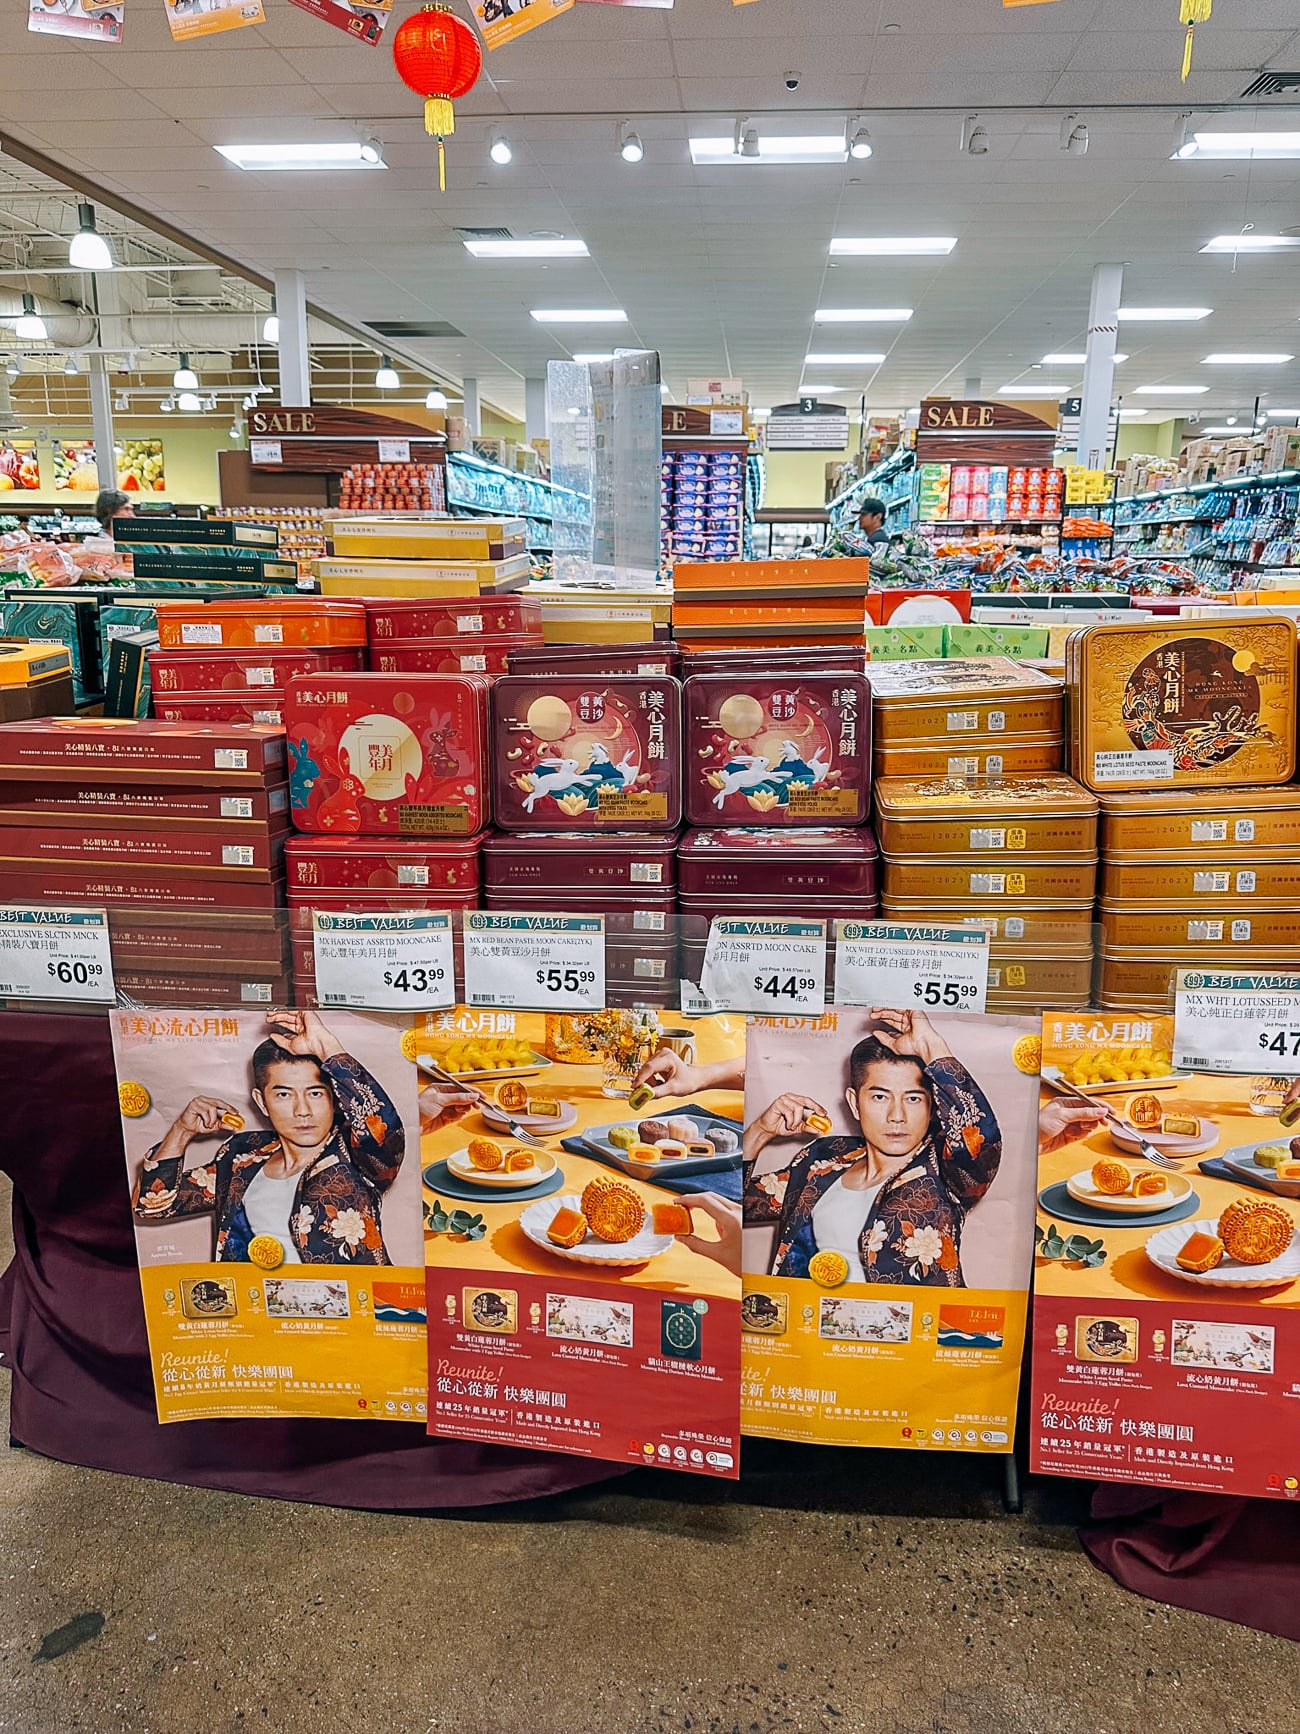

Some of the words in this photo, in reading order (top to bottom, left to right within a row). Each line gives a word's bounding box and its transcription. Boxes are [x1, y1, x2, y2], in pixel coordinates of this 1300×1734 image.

[804, 400, 813, 412] 3
[1071, 400, 1080, 411] 5
[254, 412, 316, 432] SALE
[927, 406, 995, 427] SALE
[1163, 651, 1181, 714] 美心月餅
[303, 691, 348, 704] 美心月餅
[647, 691, 666, 760] 美心月餅
[838, 688, 859, 757] 美心月餅
[31, 911, 72, 925] VALUE
[336, 918, 367, 929] BEST
[371, 918, 415, 931] VALUE
[490, 917, 523, 929] BEST
[526, 917, 569, 931] VALUE
[45, 931, 71, 940] SLCTN
[73, 931, 100, 940] MNCK
[744, 923, 789, 936] VALUE
[866, 926, 900, 938] BEST
[904, 928, 951, 942] VALUE
[319, 937, 330, 945] MX
[331, 937, 365, 946] HARVEST
[366, 938, 395, 946] ASSRTD
[396, 934, 442, 945] MOONCAKE
[729, 941, 763, 951] ASSRTD
[764, 943, 791, 952] MOON
[792, 944, 818, 953] CAKE
[320, 947, 398, 959] 美心豐年美月月餅
[470, 946, 551, 957] 美心雙黃豆沙月餅
[845, 945, 857, 953] MX
[916, 949, 939, 957] PASTE
[1208, 976, 1245, 988] BEST
[1249, 976, 1299, 990] VALUE
[1185, 994, 1203, 1005] MX
[1205, 995, 1231, 1006] WHT
[1232, 996, 1292, 1007] LOTUSSEED
[1186, 1006, 1289, 1019] 美心純正白蓮蓉月餅
[130, 1016, 239, 1037] 美心流心月餅
[436, 1012, 516, 1034] 美心月餅
[1065, 1021, 1153, 1043] 美心月餅
[160, 1348, 230, 1369] Reunite!
[162, 1364, 227, 1383] 從心從新
[232, 1364, 294, 1380] 快樂團圓
[436, 1358, 504, 1383] Reunite!
[436, 1376, 499, 1400] 從心從新
[503, 1384, 567, 1409] 快樂團圓
[770, 1384, 838, 1405] 快樂團圓
[1040, 1392, 1120, 1416] Reunite!
[1040, 1411, 1114, 1435] 從心從新
[1119, 1418, 1194, 1442] 快樂團圓
